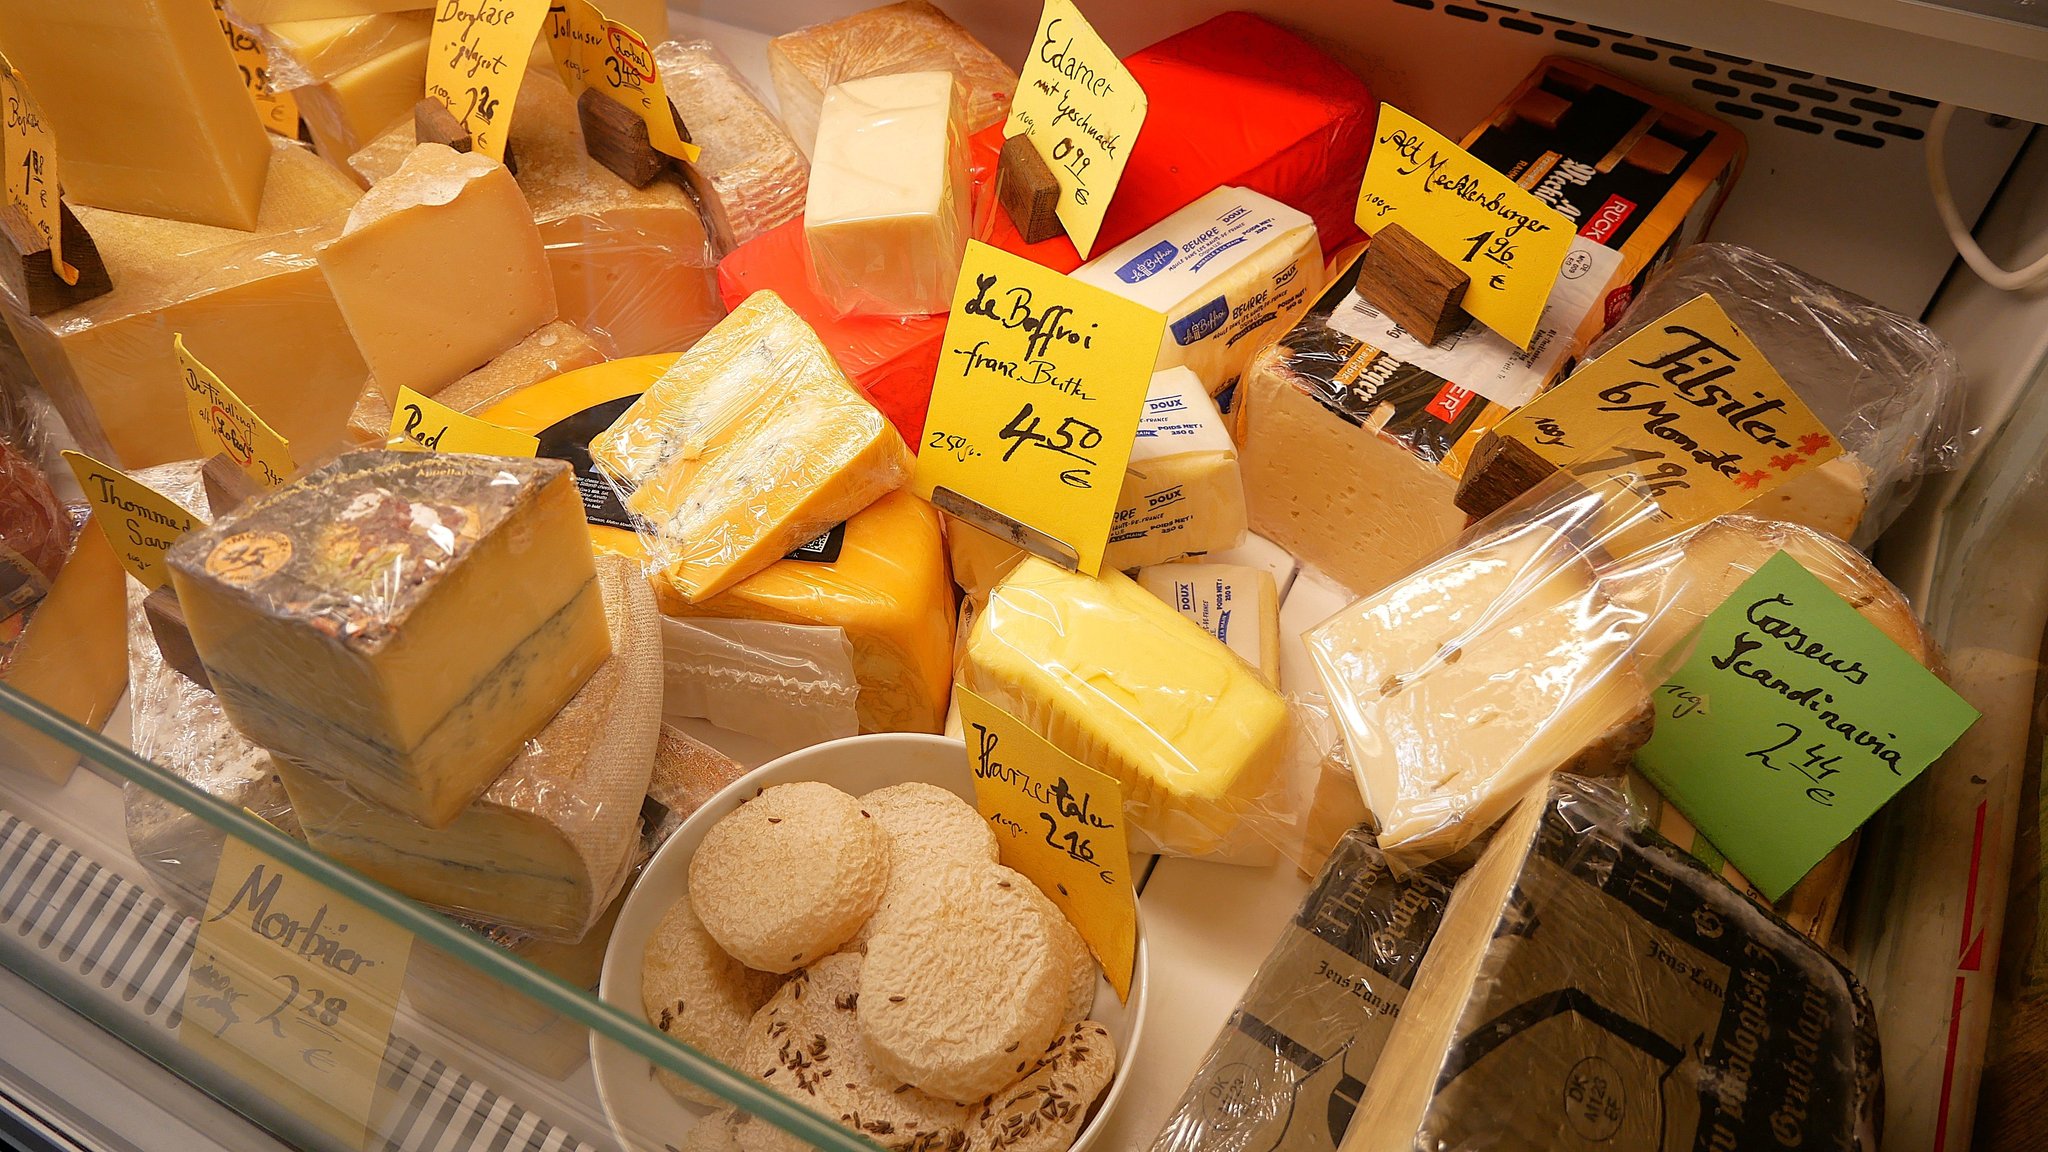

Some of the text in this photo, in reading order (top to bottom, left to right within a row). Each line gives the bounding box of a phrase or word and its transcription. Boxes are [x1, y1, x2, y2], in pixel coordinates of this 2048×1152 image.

[1041, 18, 1115, 98] Edamer
[1222, 206, 1247, 224] DOUX
[1585, 200, 1628, 240] RÜCK
[1182, 226, 1220, 254] BEURRE
[1275, 264, 1297, 285] DOUX
[1232, 290, 1268, 320] BEURRE
[1628, 325, 1792, 449] Tilsiter
[1149, 398, 1183, 411] DOUX
[1597, 400, 1743, 480] Monate
[1059, 468, 1093, 490] €
[1149, 489, 1183, 507] DOUX
[1150, 520, 1174, 531] POIDS
[1180, 583, 1191, 611] DOUX
[1746, 593, 1869, 686] Caseus
[1711, 632, 1902, 777] Scandinavia
[1806, 786, 1835, 807] €
[1099, 870, 1116, 885] €
[207, 863, 376, 977] Morbier
